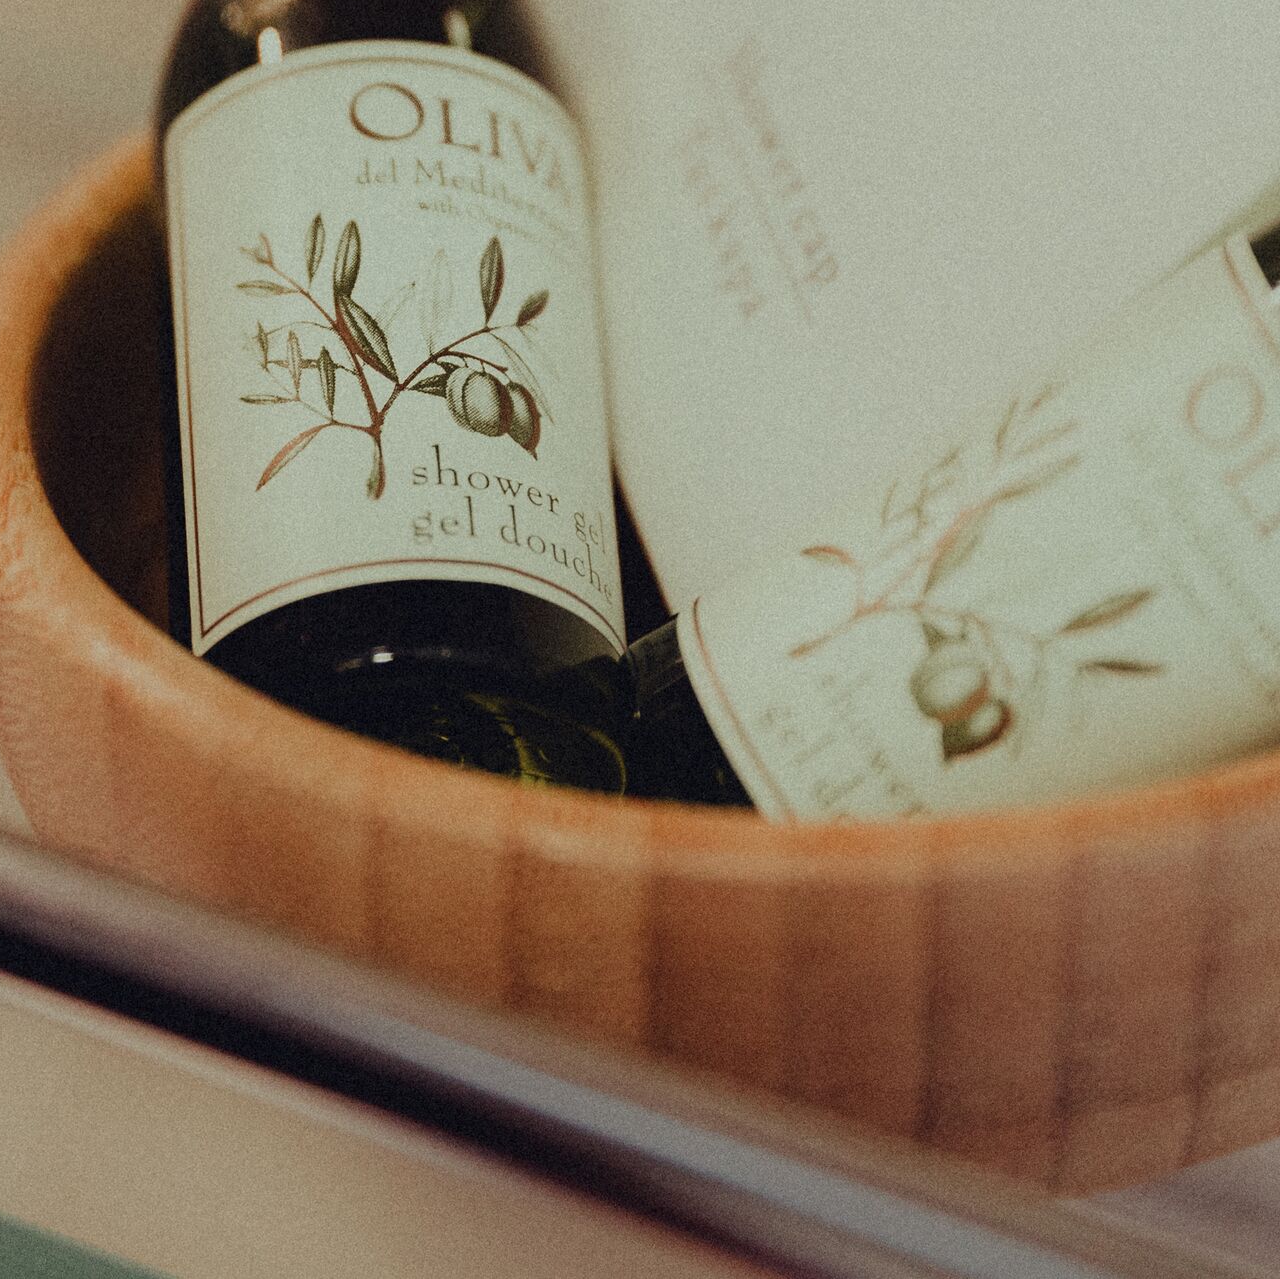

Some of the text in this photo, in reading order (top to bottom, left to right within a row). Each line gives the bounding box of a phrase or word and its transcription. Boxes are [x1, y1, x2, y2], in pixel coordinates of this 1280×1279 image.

[349, 82, 573, 210] OLIVA
[356, 157, 398, 185] del
[411, 443, 606, 556] shower gel
[412, 494, 614, 605] gel douche
